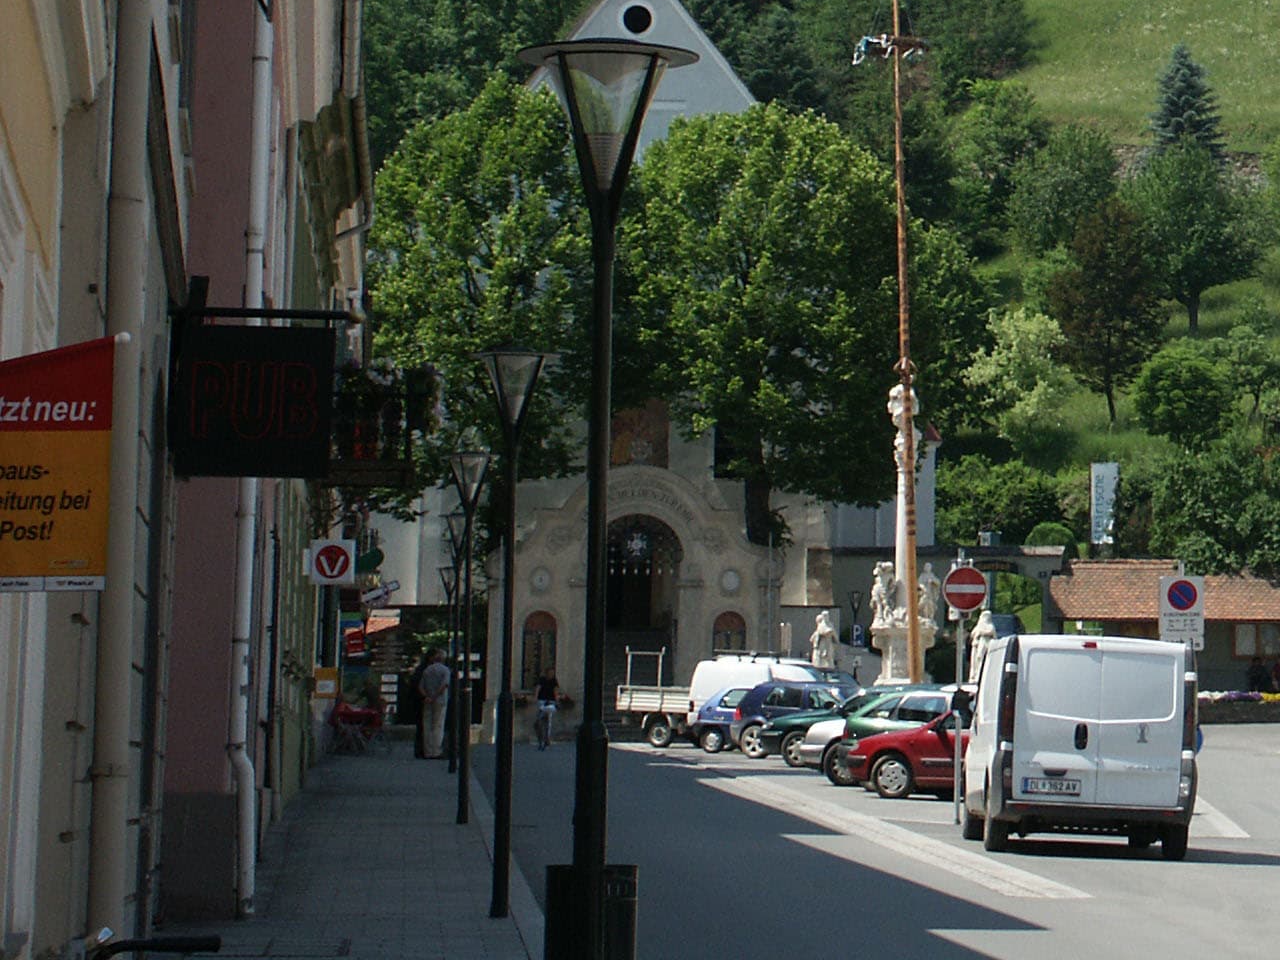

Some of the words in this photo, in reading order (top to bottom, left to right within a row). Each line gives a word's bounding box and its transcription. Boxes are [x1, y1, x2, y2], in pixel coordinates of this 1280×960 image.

[191, 360, 321, 439] PUB
[33, 400, 97, 422] neu:
[0, 490, 56, 516] itung
[59, 489, 92, 510] bei
[0, 520, 55, 541] Post!
[319, 554, 346, 577] V
[853, 624, 862, 640] P
